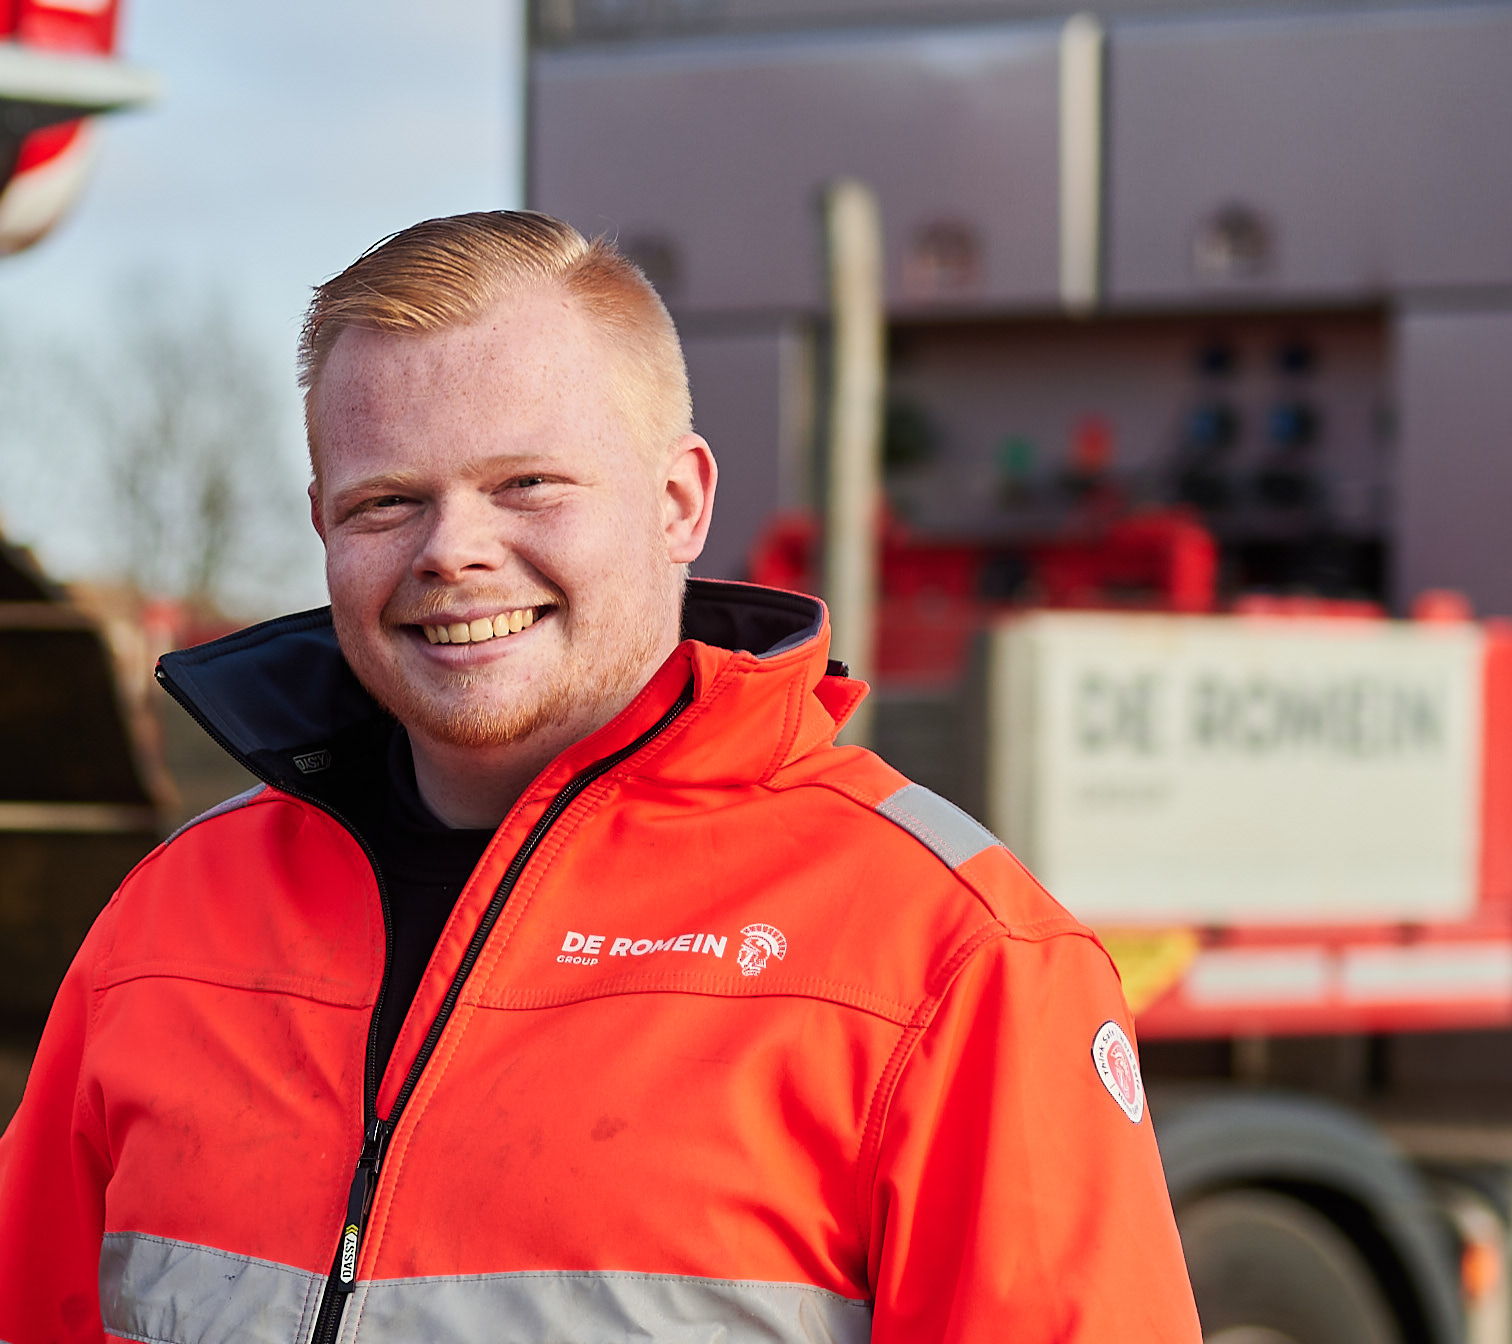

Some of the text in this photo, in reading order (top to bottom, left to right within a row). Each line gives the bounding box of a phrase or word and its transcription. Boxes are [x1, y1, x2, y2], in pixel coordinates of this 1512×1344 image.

[1077, 667, 1446, 757] DE ROMEIN
[561, 931, 727, 958] DE ROMEIN
[556, 954, 598, 966] GROUP
